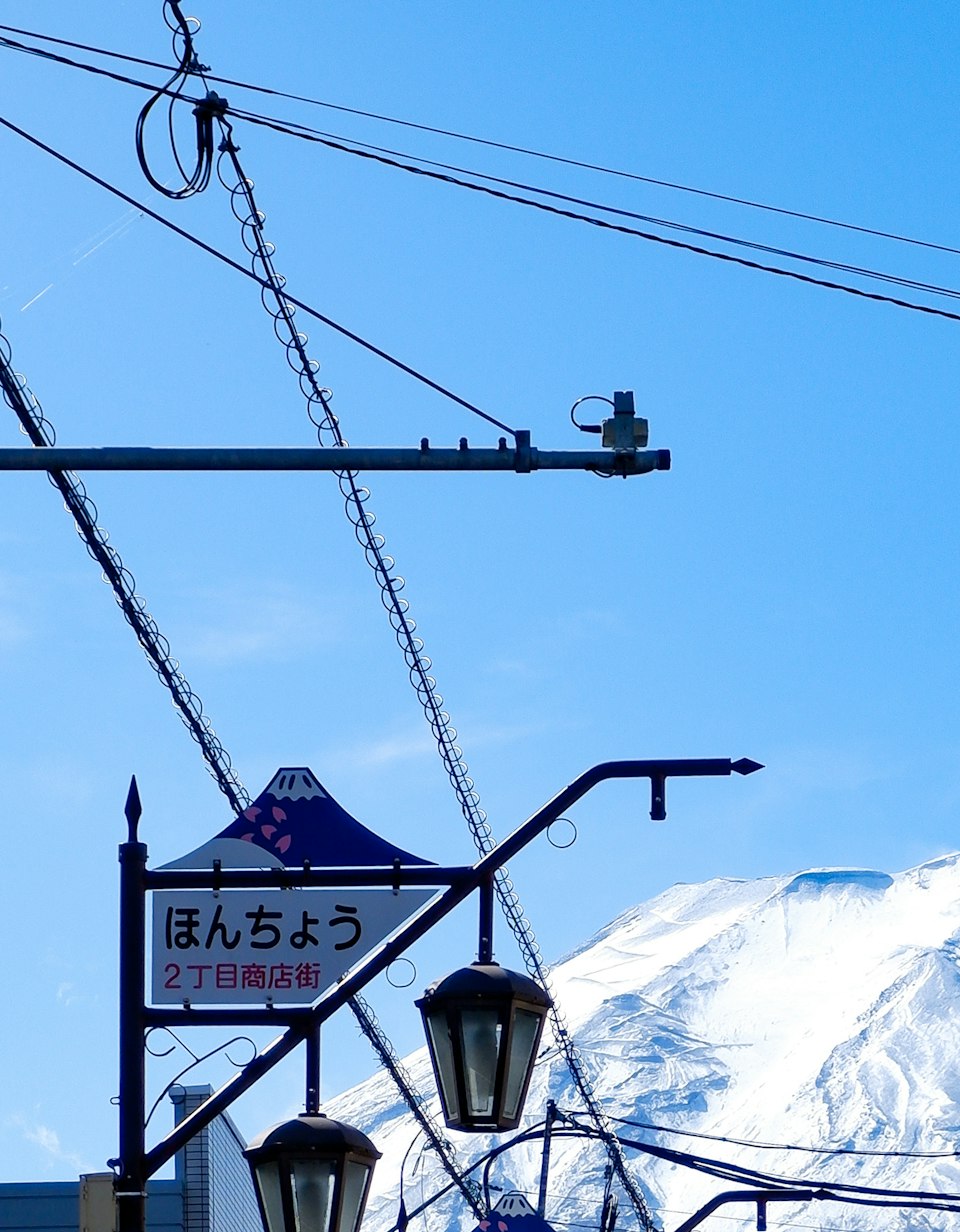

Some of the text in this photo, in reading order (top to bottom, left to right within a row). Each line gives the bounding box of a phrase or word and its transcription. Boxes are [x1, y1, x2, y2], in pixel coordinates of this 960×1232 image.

[164, 904, 363, 951] ほんちょう
[163, 963, 321, 990] 2丁目商店街
